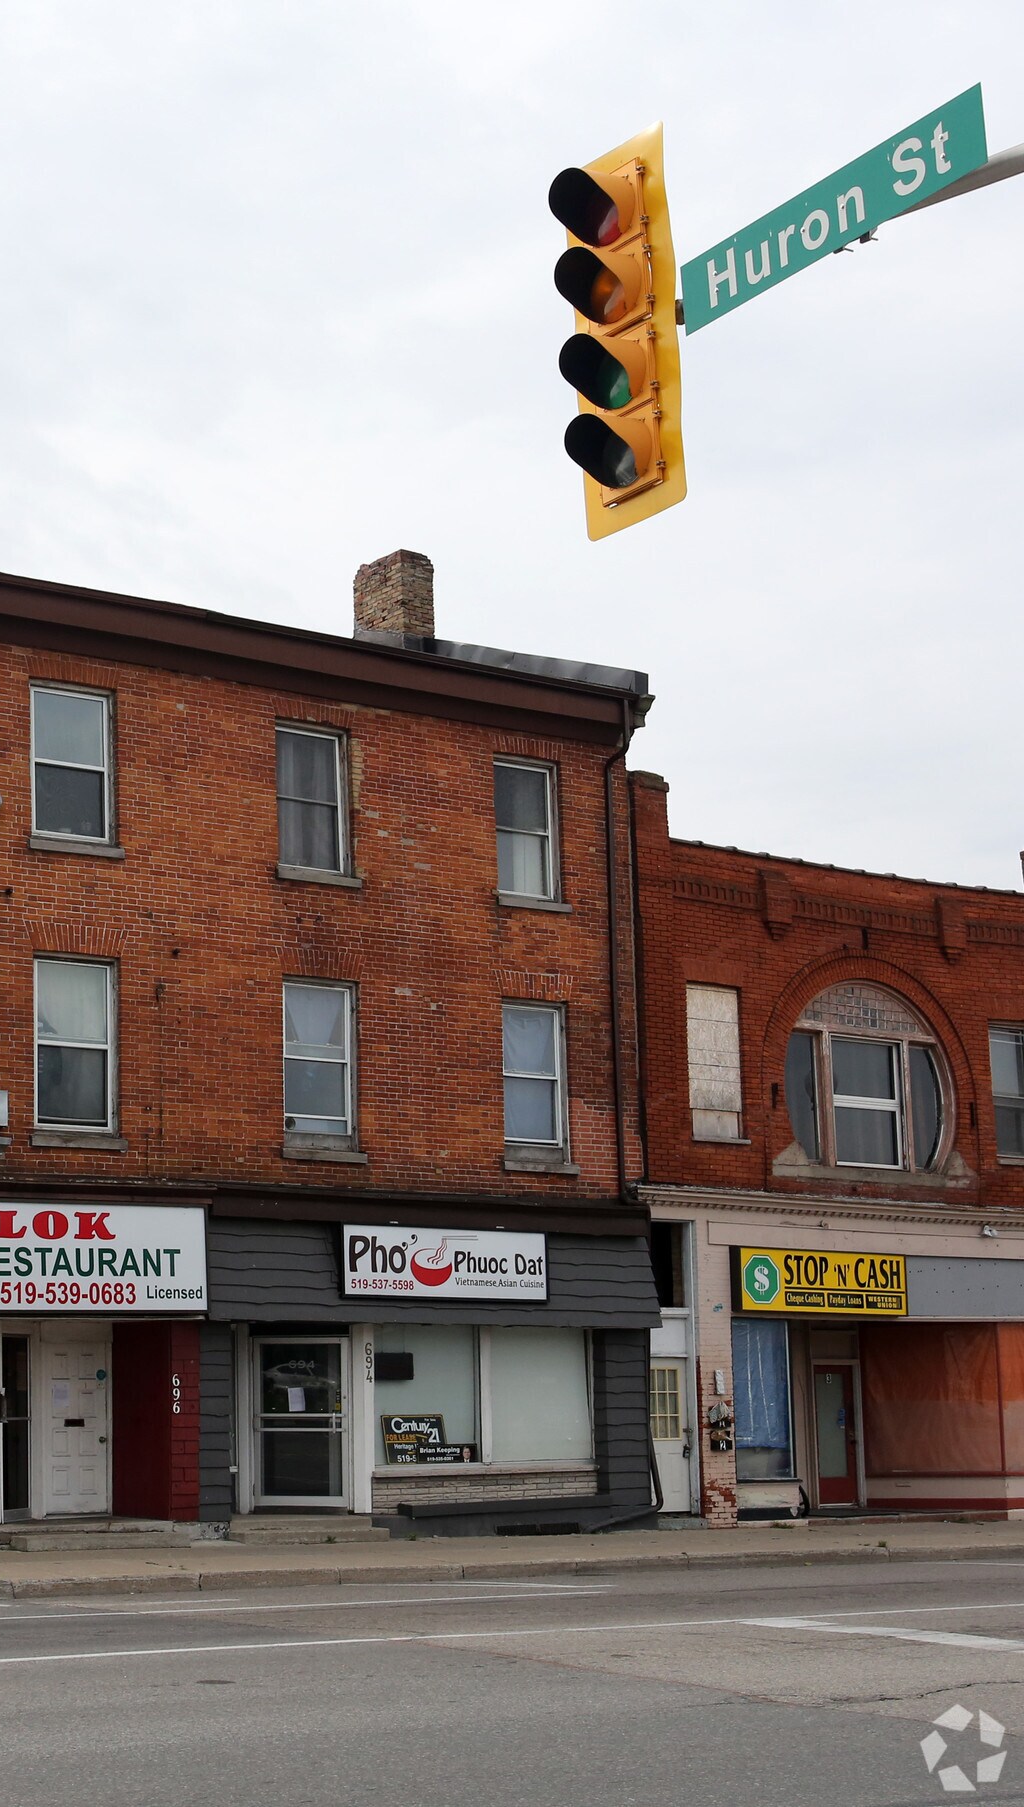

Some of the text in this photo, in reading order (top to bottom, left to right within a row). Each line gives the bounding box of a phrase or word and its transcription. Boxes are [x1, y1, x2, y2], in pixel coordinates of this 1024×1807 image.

[706, 120, 952, 309] Huron St
[453, 1250, 544, 1276] Phuoc Dat
[783, 1254, 829, 1287] STOP
[854, 1257, 902, 1289] CASH
[350, 1278, 415, 1291] 519-537-5598
[519, 1279, 545, 1289] Cuisine
[0, 1281, 137, 1305] 519-539-0683
[145, 1284, 204, 1300] Licensed
[786, 1292, 824, 1306] Cheque Cashing
[829, 1294, 862, 1306] Payday Loans
[288, 1360, 315, 1369] 694
[364, 1342, 373, 1383] 694
[172, 1373, 181, 1414] 696
[391, 1417, 431, 1434] Century
[427, 1428, 441, 1443] 21
[436, 1446, 461, 1454] Keeping
